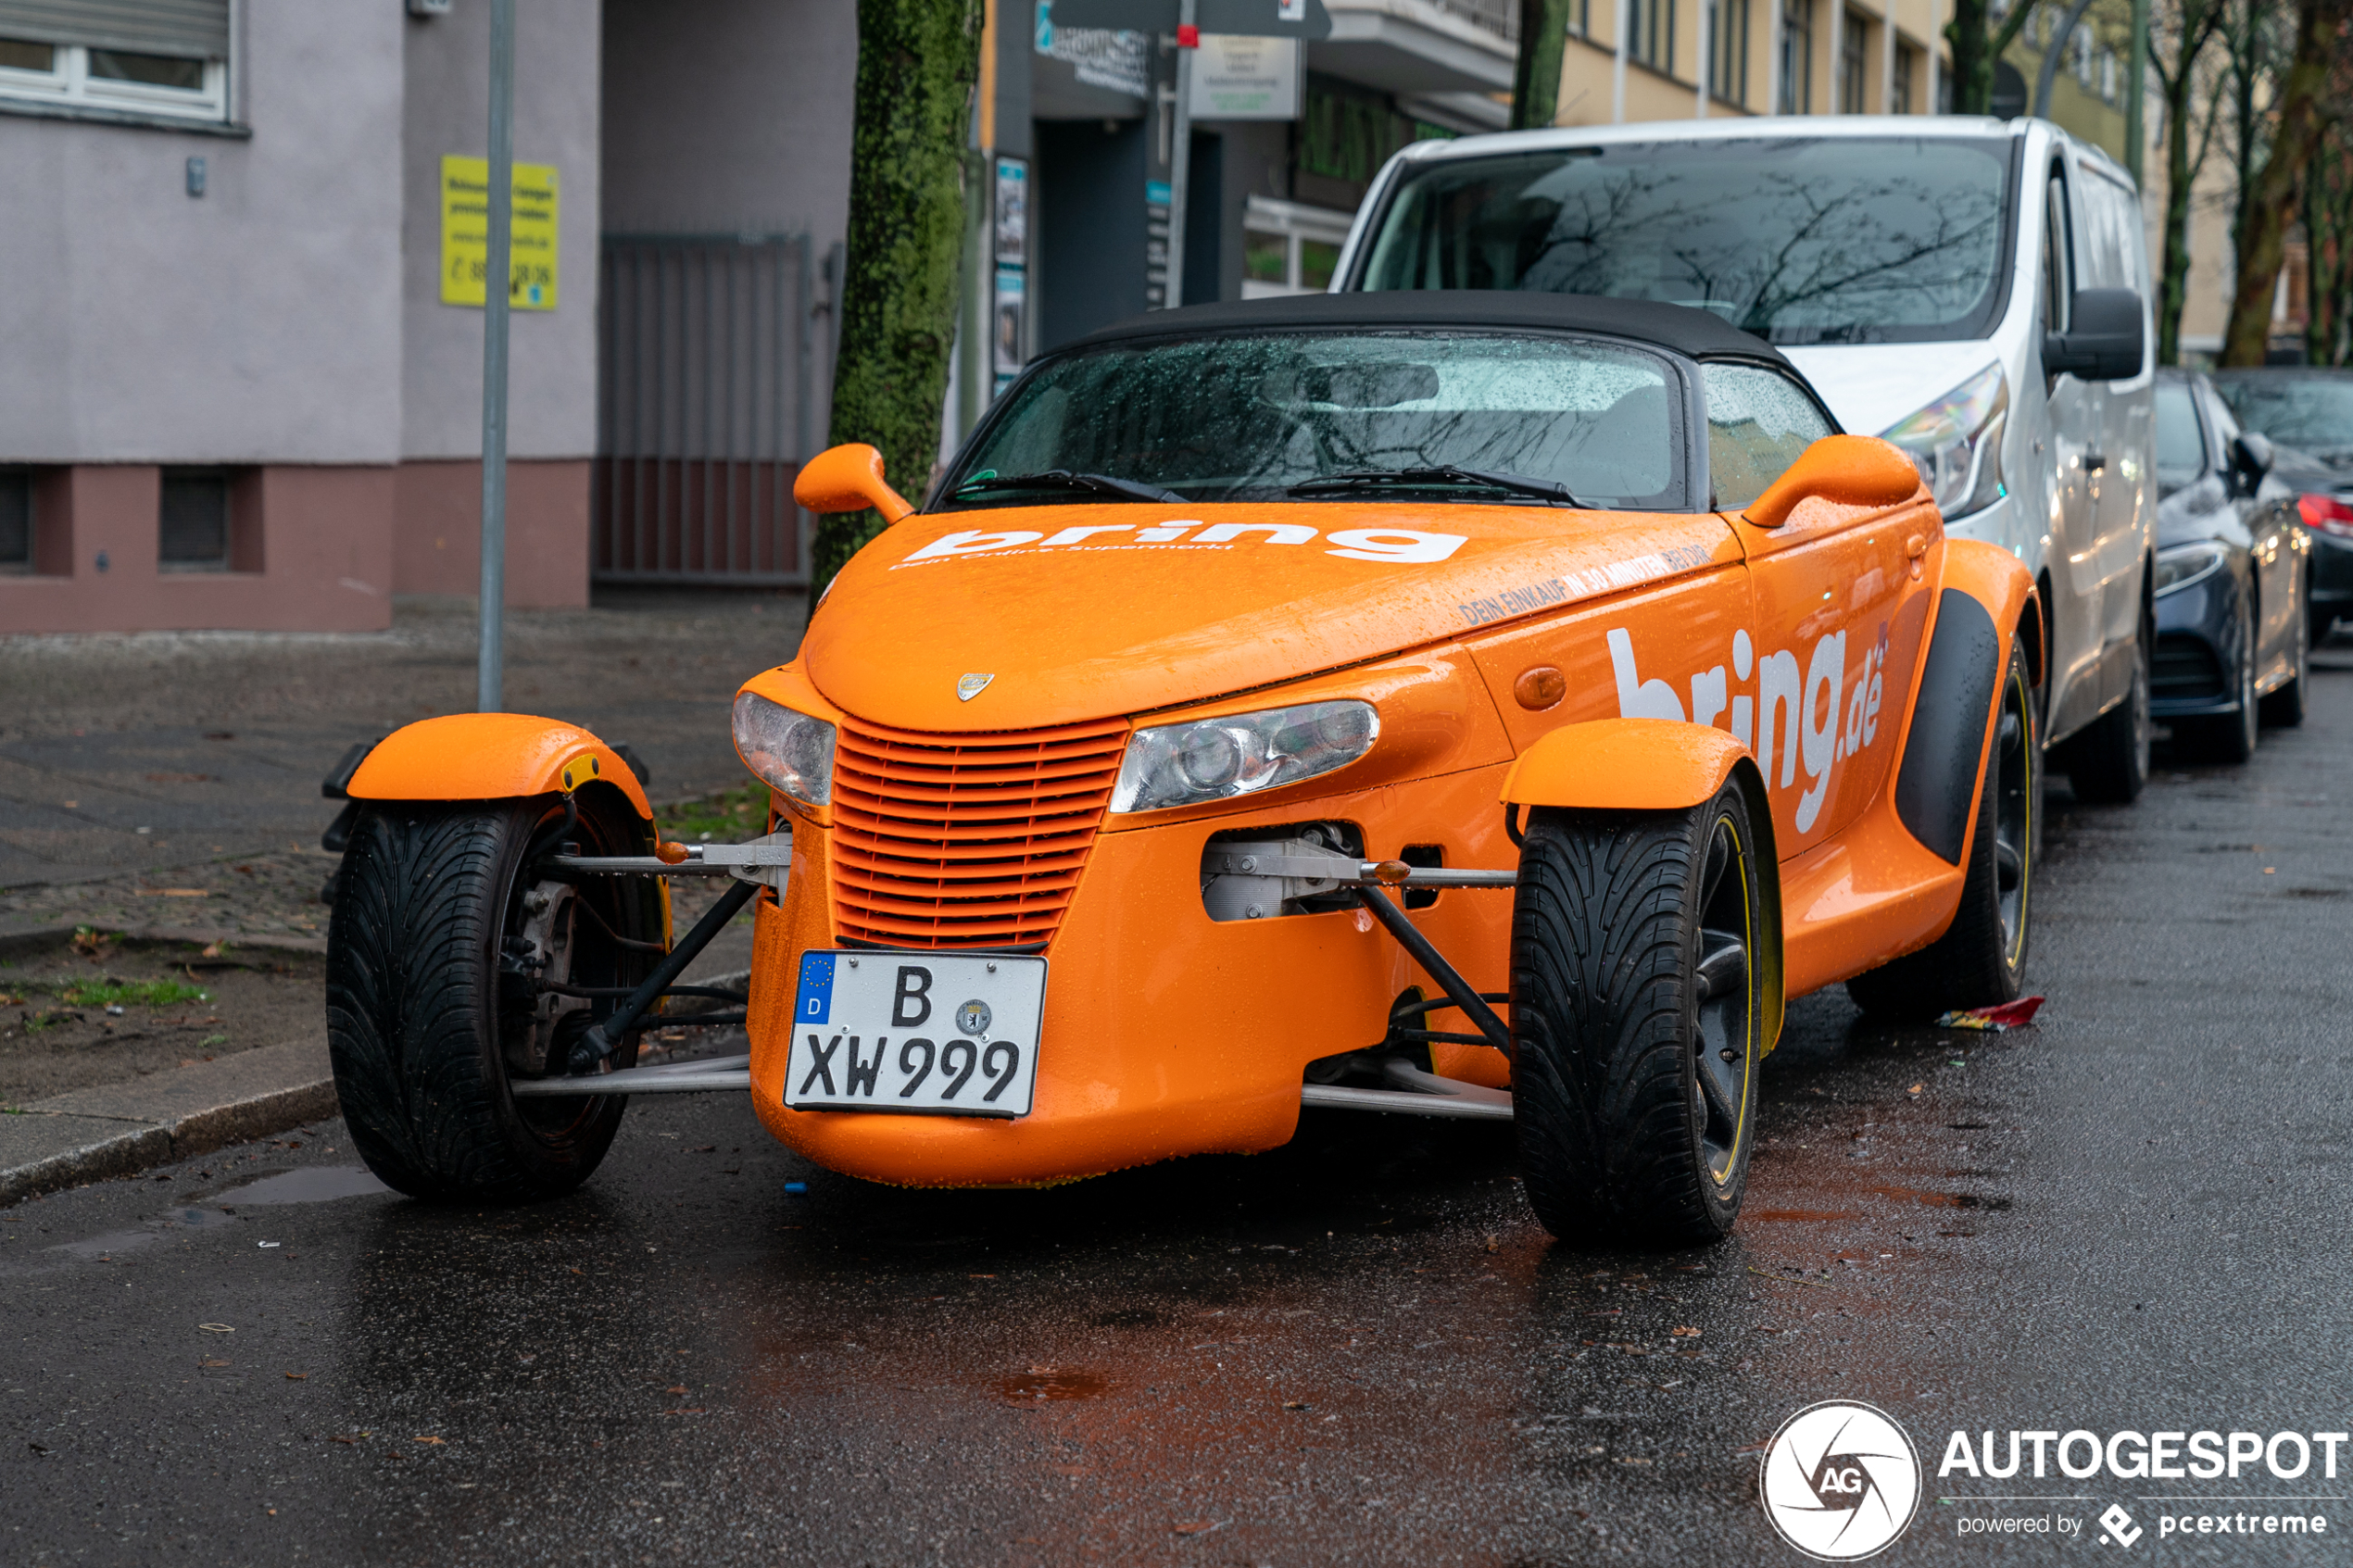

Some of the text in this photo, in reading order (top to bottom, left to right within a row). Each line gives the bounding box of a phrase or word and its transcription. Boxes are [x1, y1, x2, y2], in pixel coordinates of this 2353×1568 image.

[887, 558, 951, 571] Dein
[902, 520, 1469, 563] bring
[1458, 597, 1507, 626] DEIN
[1499, 578, 1567, 615] EINKAUF
[1561, 572, 1590, 597] IN
[1581, 568, 1609, 592] 30
[1600, 553, 1671, 587] MINUTEN
[1660, 548, 1691, 571] BEI
[807, 997, 822, 1016] D
[891, 965, 933, 1027] B
[799, 1034, 1020, 1102] XW 999
